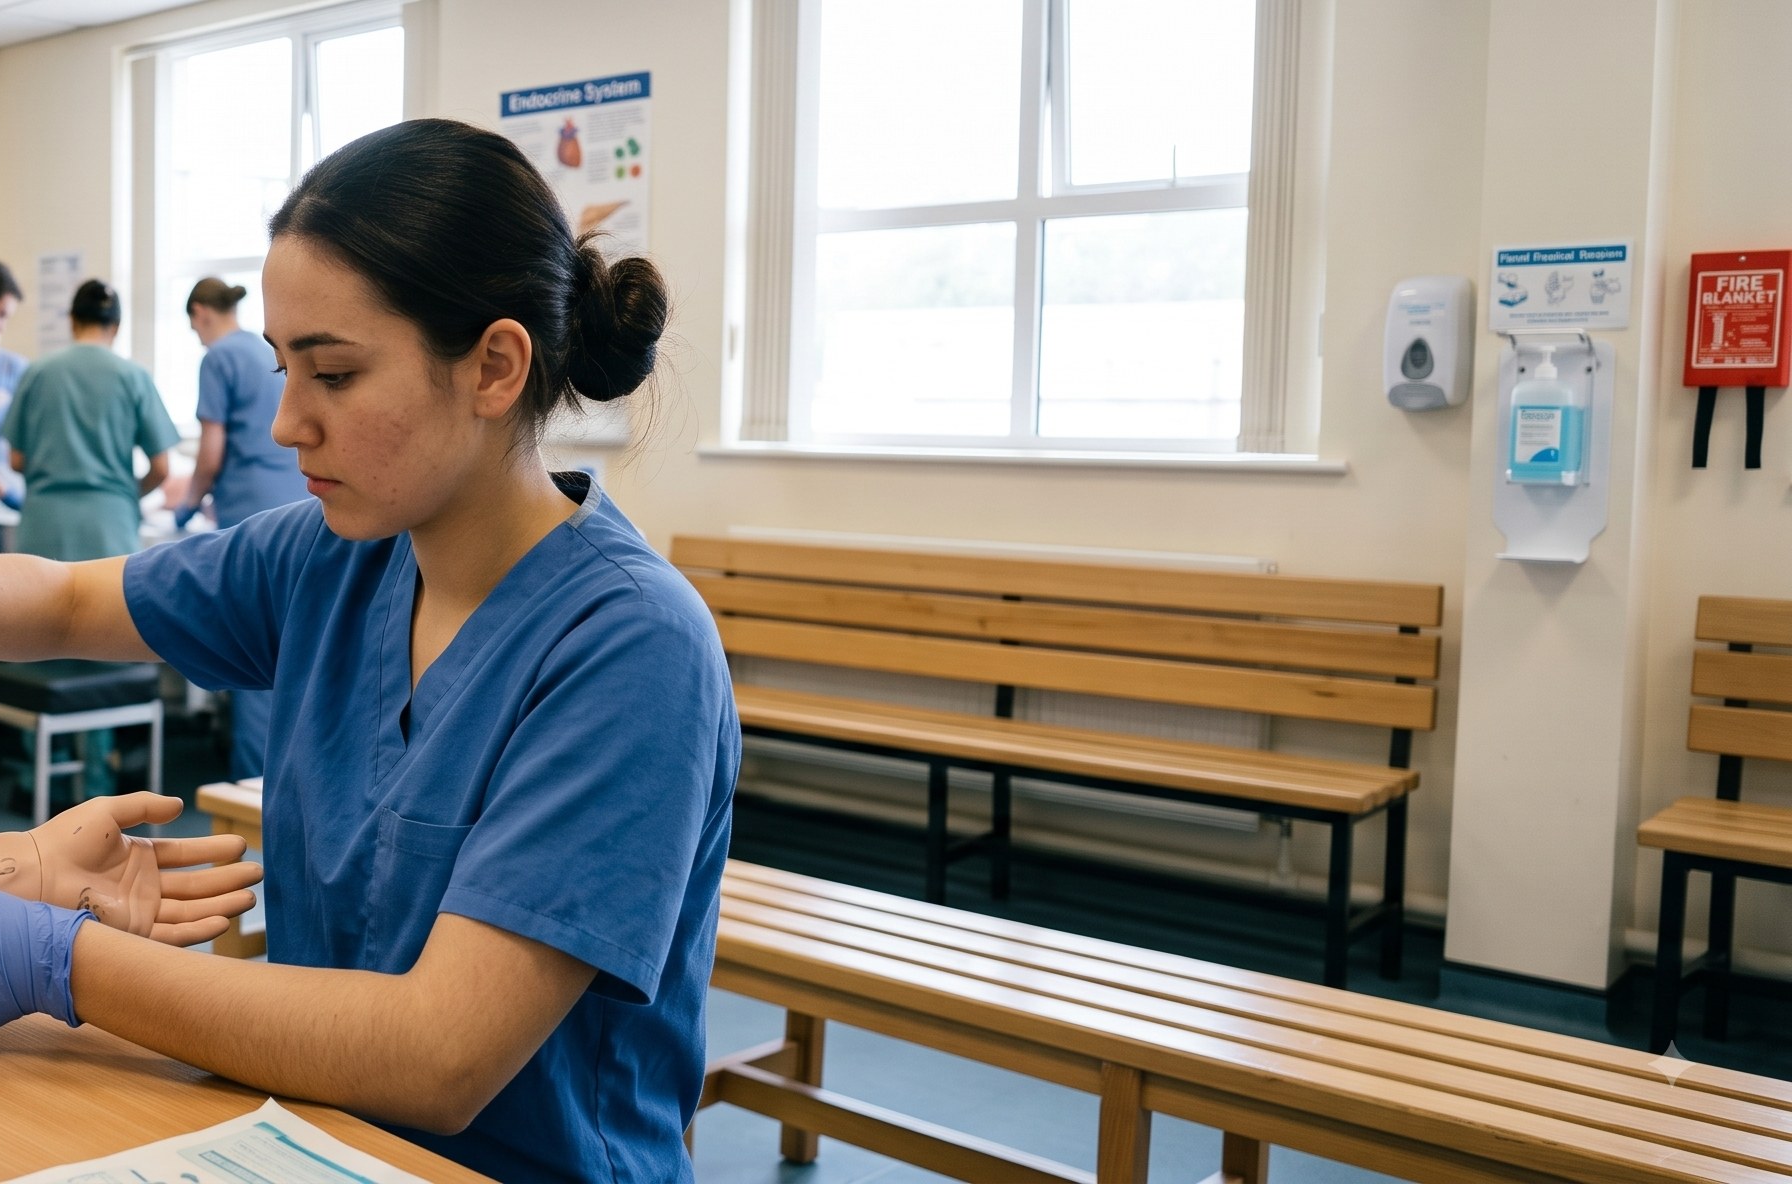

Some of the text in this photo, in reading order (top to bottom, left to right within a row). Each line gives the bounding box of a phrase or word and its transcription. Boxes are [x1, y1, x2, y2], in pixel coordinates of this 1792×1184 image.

[509, 79, 642, 113] Endocrine System
[1716, 275, 1764, 292] FIRE
[1702, 290, 1777, 305] BLANKET
